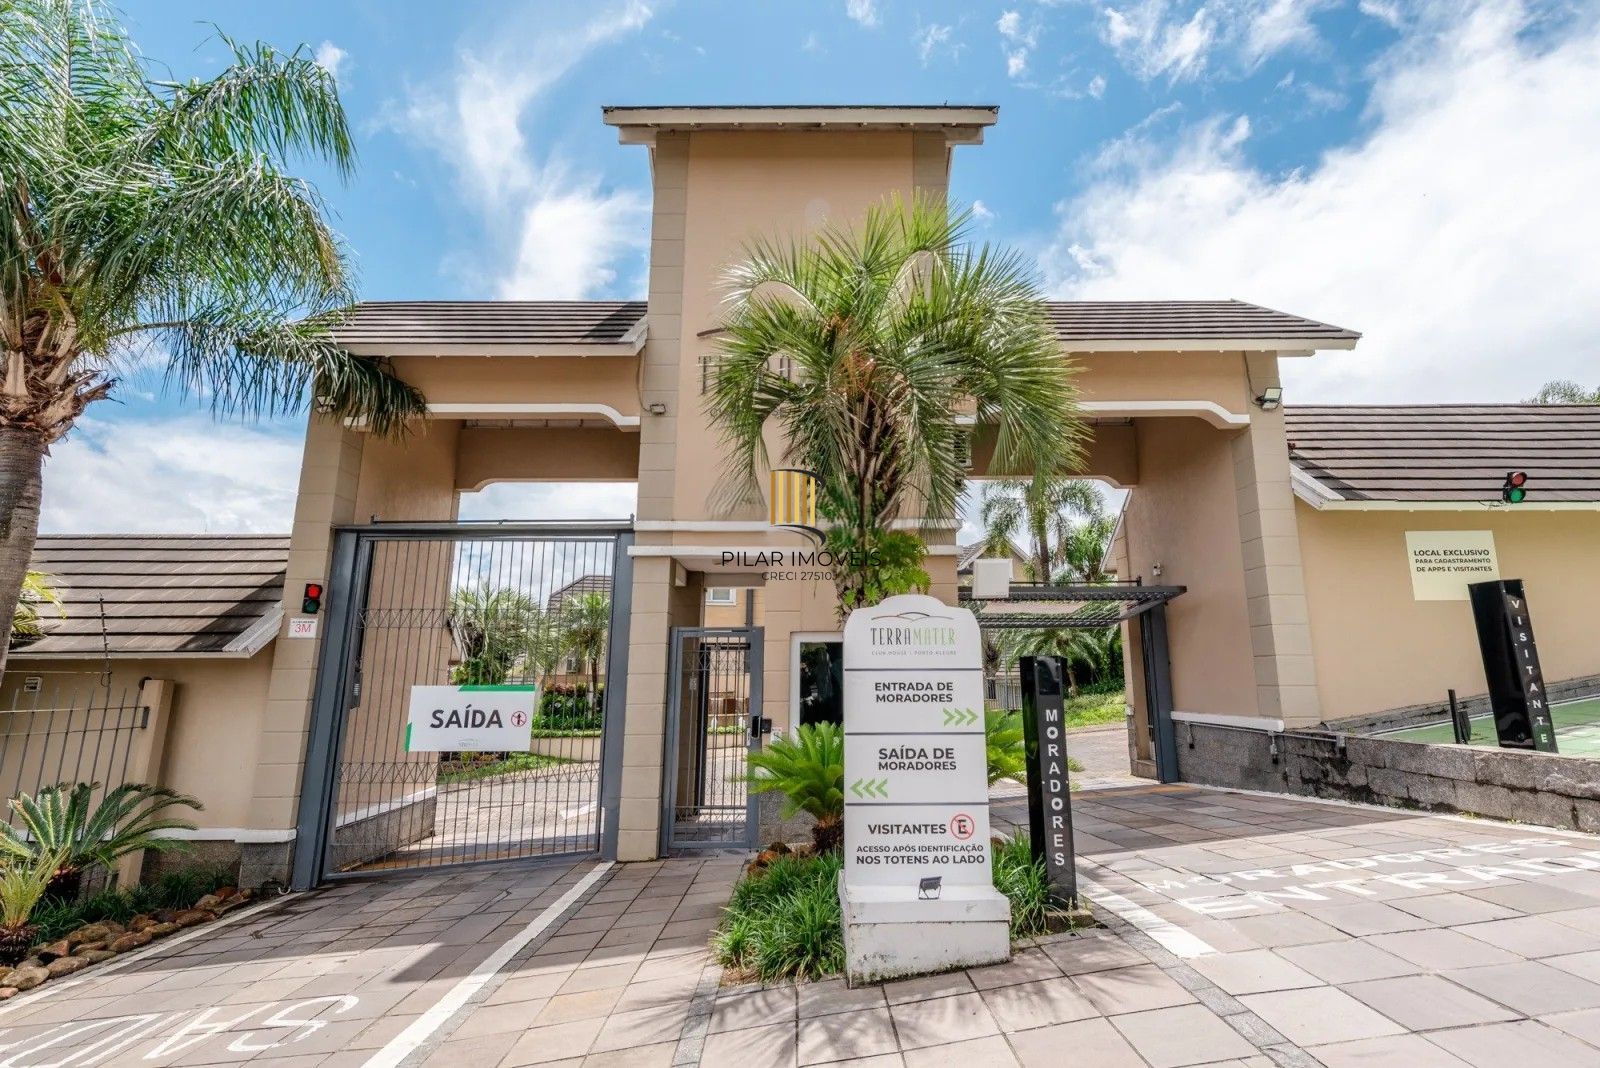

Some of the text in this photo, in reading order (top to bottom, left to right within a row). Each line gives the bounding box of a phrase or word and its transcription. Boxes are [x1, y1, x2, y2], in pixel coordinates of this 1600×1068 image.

[295, 623, 312, 633] 3M
[874, 682, 954, 692] ENTRADA DE
[876, 693, 953, 703] MORADORES
[429, 704, 503, 729] SAÍDA
[878, 744, 955, 760] SAÍDA DE
[878, 761, 957, 771] MORADORES
[1045, 709, 1066, 866] MORADORES
[867, 823, 947, 835] VISITANTES
[856, 843, 984, 854] ACESSO APÓS IDENTIFICAÇÃO
[856, 854, 985, 865] NOS TOTENS AO LADO
[1177, 850, 1600, 915] ENTRAD
